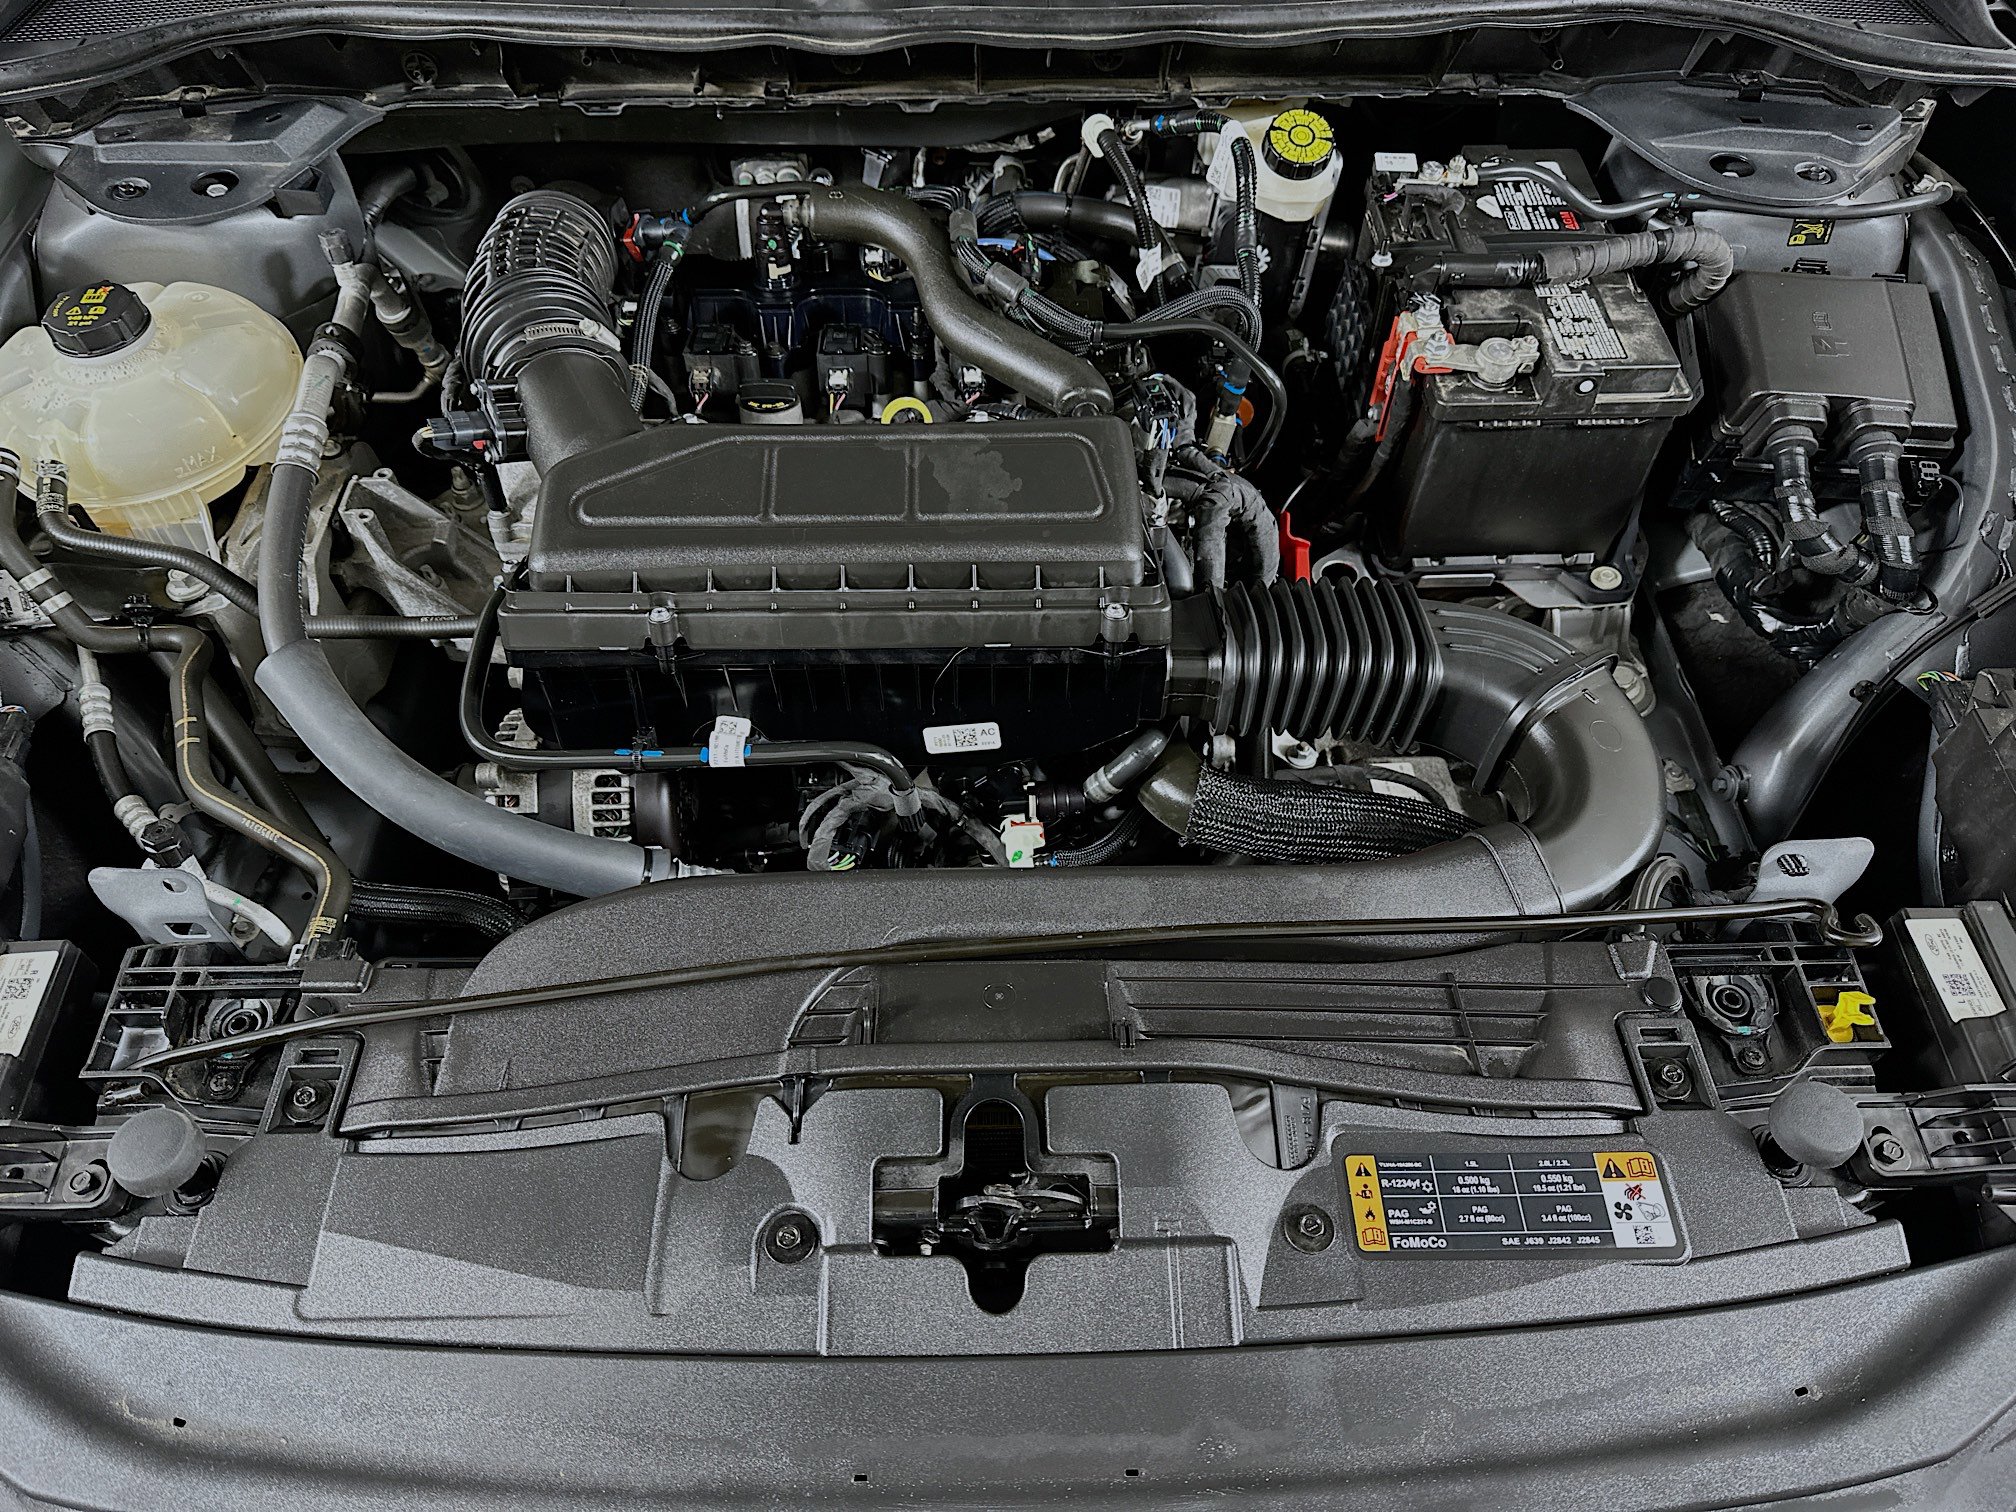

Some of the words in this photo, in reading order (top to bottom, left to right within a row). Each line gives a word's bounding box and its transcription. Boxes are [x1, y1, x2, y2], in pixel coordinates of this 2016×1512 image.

[980, 727, 996, 736] AC
[1457, 1175, 1479, 1185] 0.500
[1479, 1175, 1491, 1186] kg
[1540, 1174, 1562, 1183] 0.550
[1562, 1173, 1574, 1184] kg
[1380, 1178, 1421, 1190] R-1234yf
[1532, 1184, 1547, 1192] 19.5
[1556, 1183, 1573, 1193] (1.21
[1572, 1183, 1587, 1193] lbs)
[1461, 1186, 1470, 1194] oz
[1470, 1185, 1487, 1195] (1.10
[1486, 1185, 1500, 1195] lbs)
[1387, 1208, 1410, 1218] PAG
[1471, 1205, 1489, 1214] PAG
[1555, 1204, 1573, 1213] PAG
[1475, 1215, 1485, 1223] oz
[1567, 1213, 1592, 1223] (100cc)
[1392, 1235, 1448, 1249] FoMoCo
[1501, 1237, 1521, 1246] SAE
[1524, 1237, 1545, 1245] J639
[1547, 1236, 1572, 1245] J2842
[1576, 1235, 1601, 1244] J2845
